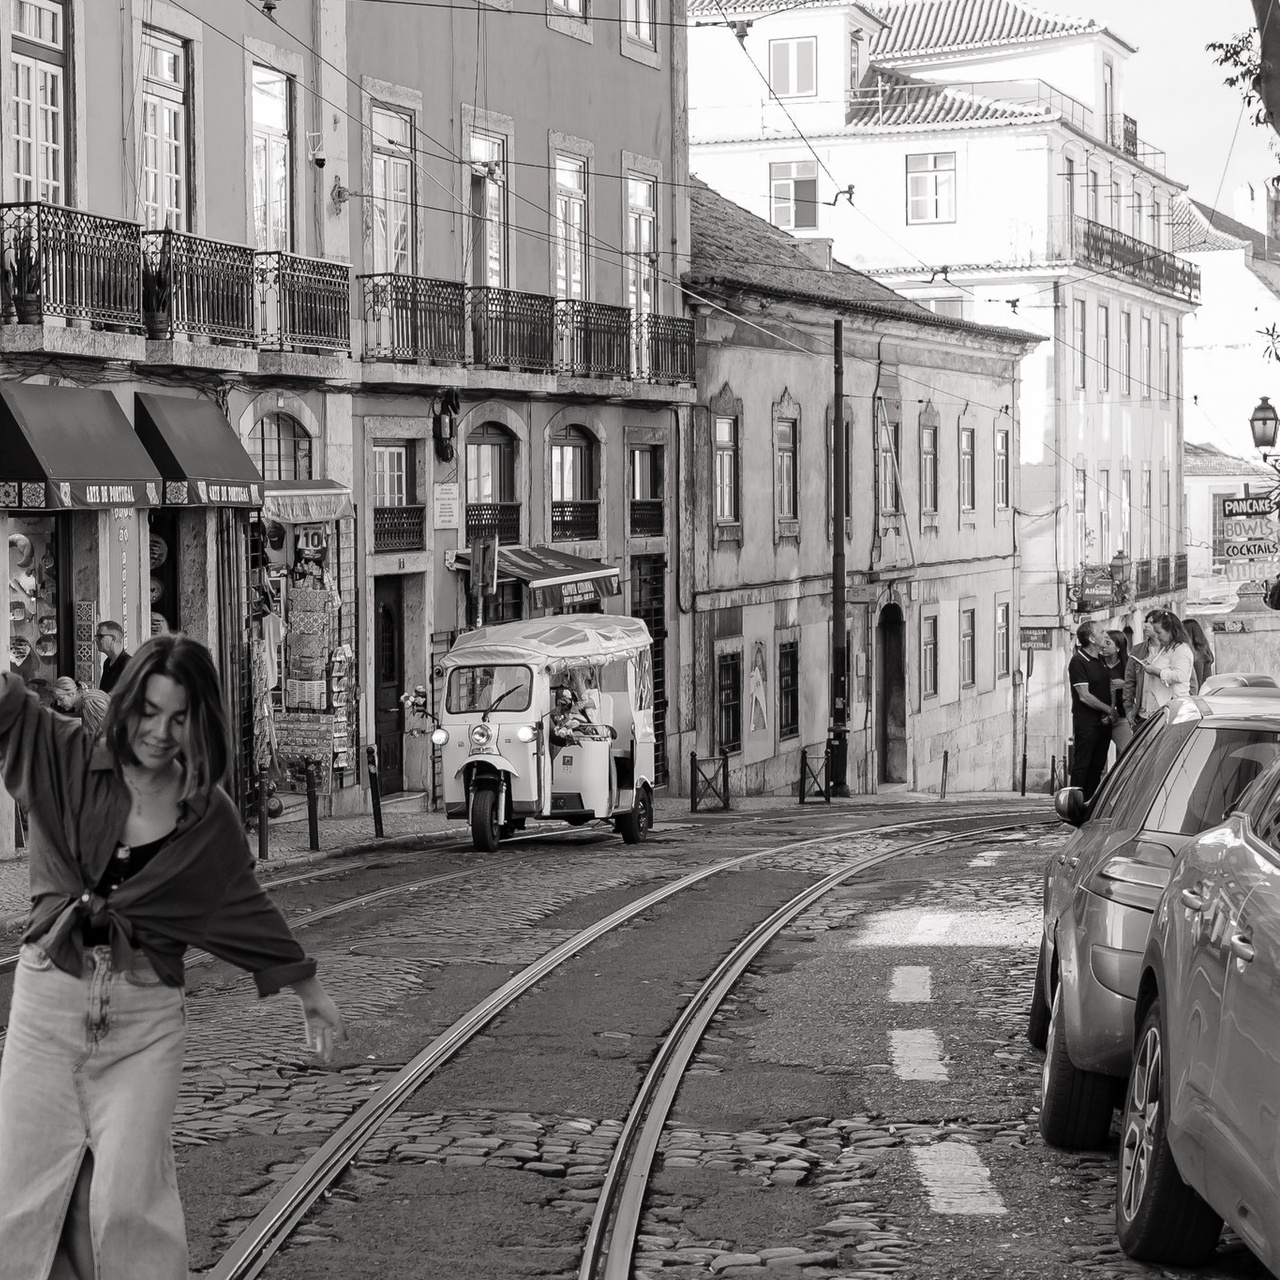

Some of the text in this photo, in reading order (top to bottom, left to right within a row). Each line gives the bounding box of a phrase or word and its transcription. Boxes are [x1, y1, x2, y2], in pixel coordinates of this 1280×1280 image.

[86, 485, 100, 503] ARTE
[109, 485, 135, 503] PORTUGAL
[227, 486, 250, 502] PORTUGAL
[1225, 499, 1278, 515] PANCAKES
[1226, 520, 1274, 538] BOWLS
[303, 531, 321, 549] 10
